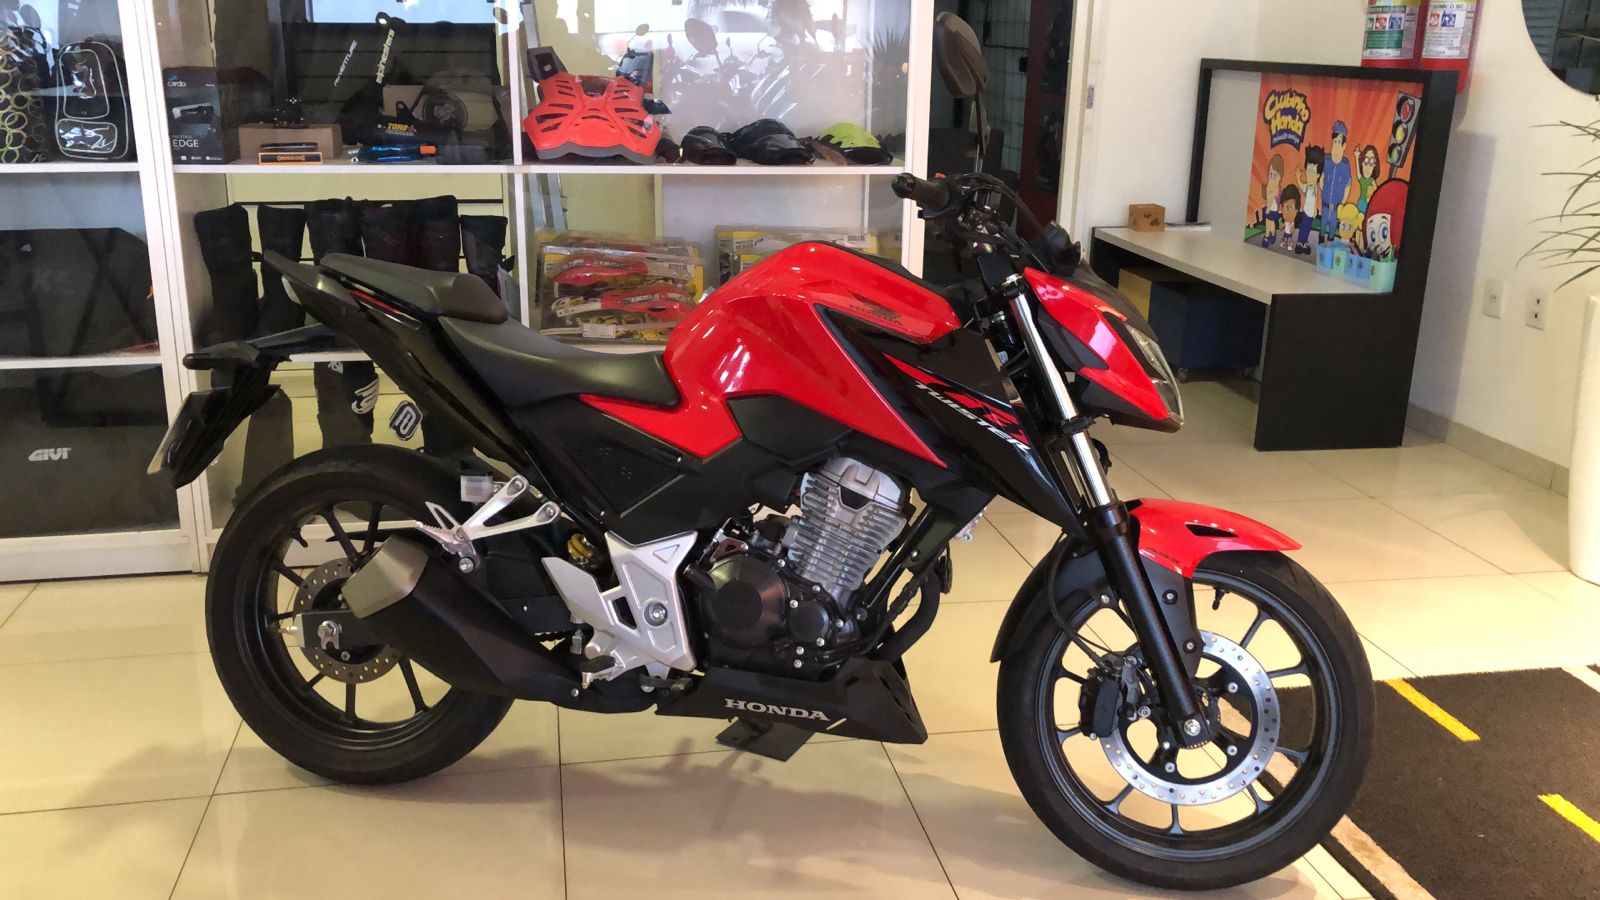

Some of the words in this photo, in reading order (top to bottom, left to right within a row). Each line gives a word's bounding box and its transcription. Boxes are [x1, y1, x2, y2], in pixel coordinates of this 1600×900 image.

[1264, 93, 1310, 121] Clubinho
[387, 122, 409, 131] TORO
[1271, 113, 1304, 136] Honda
[172, 139, 199, 147] EDGE
[914, 379, 1031, 451] TWISTER
[28, 448, 72, 461] GIVI
[725, 698, 830, 721] HONDA
